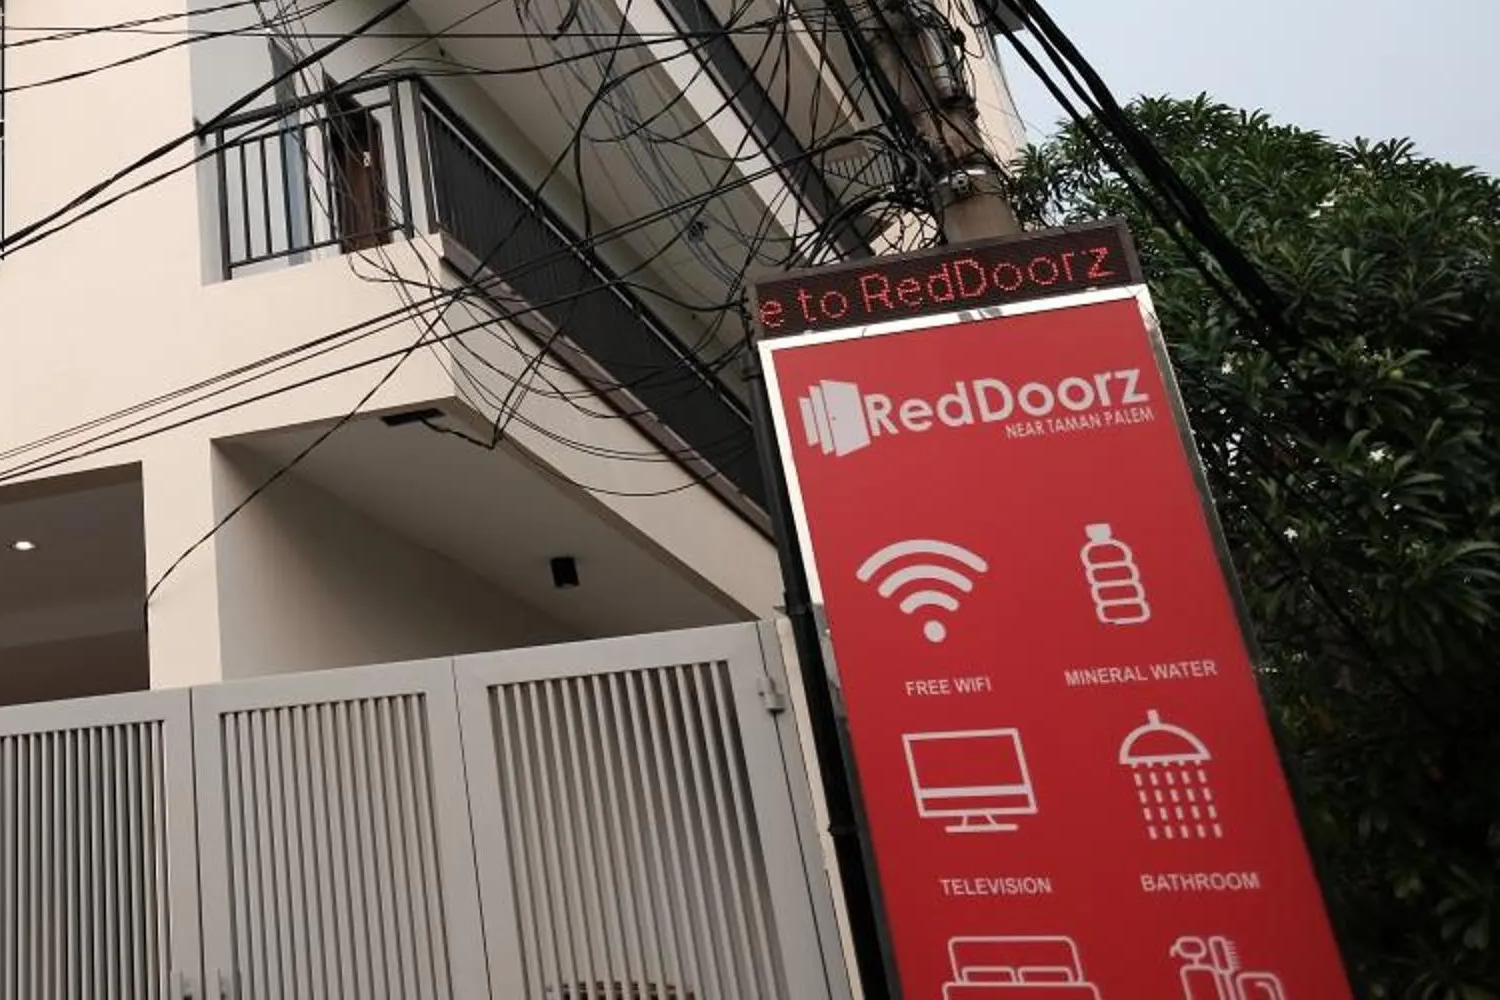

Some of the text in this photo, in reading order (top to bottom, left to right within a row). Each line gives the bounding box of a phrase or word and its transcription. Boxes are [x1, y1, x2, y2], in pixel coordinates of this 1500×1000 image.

[798, 287, 848, 322] to
[860, 246, 1115, 314] RedDoorz
[863, 367, 1150, 438] RedDoorz
[1005, 406, 1155, 440] NEAR TAMAN PALEM
[905, 676, 993, 697] FREE WIFI
[1064, 659, 1218, 687] MINERAL WATER
[939, 876, 1053, 897] TELEVISION
[1140, 871, 1261, 893] BATHROOM
